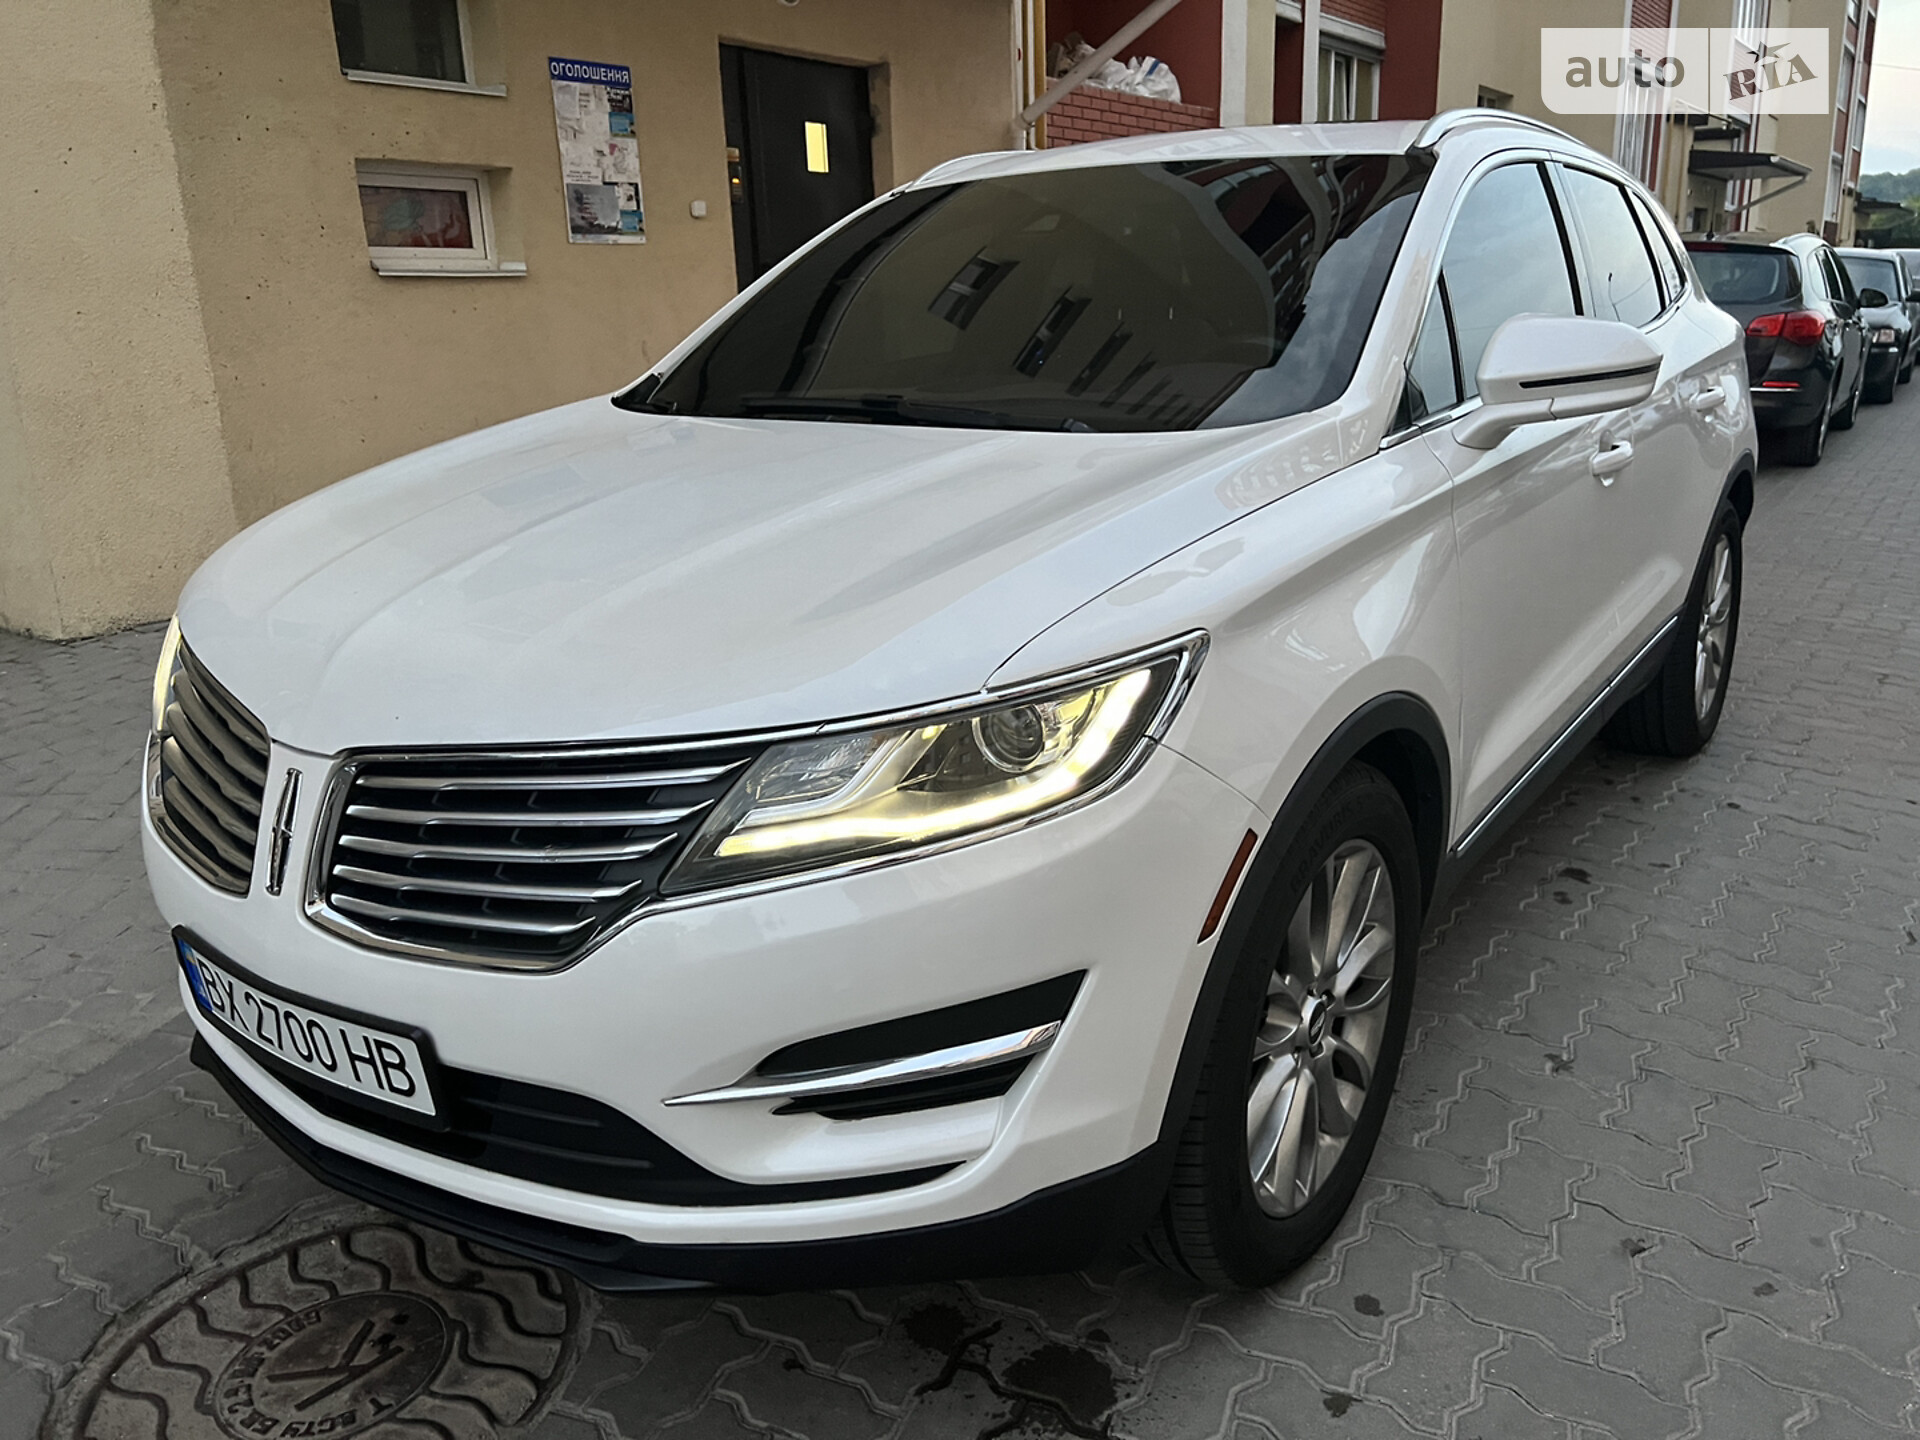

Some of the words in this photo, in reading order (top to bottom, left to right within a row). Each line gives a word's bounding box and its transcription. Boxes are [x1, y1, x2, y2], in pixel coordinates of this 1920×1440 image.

[551, 62, 629, 84] ОГОЛОШЕННЯ
[196, 957, 250, 1032] BX
[244, 991, 338, 1073] 2700
[339, 1028, 416, 1098] HB
